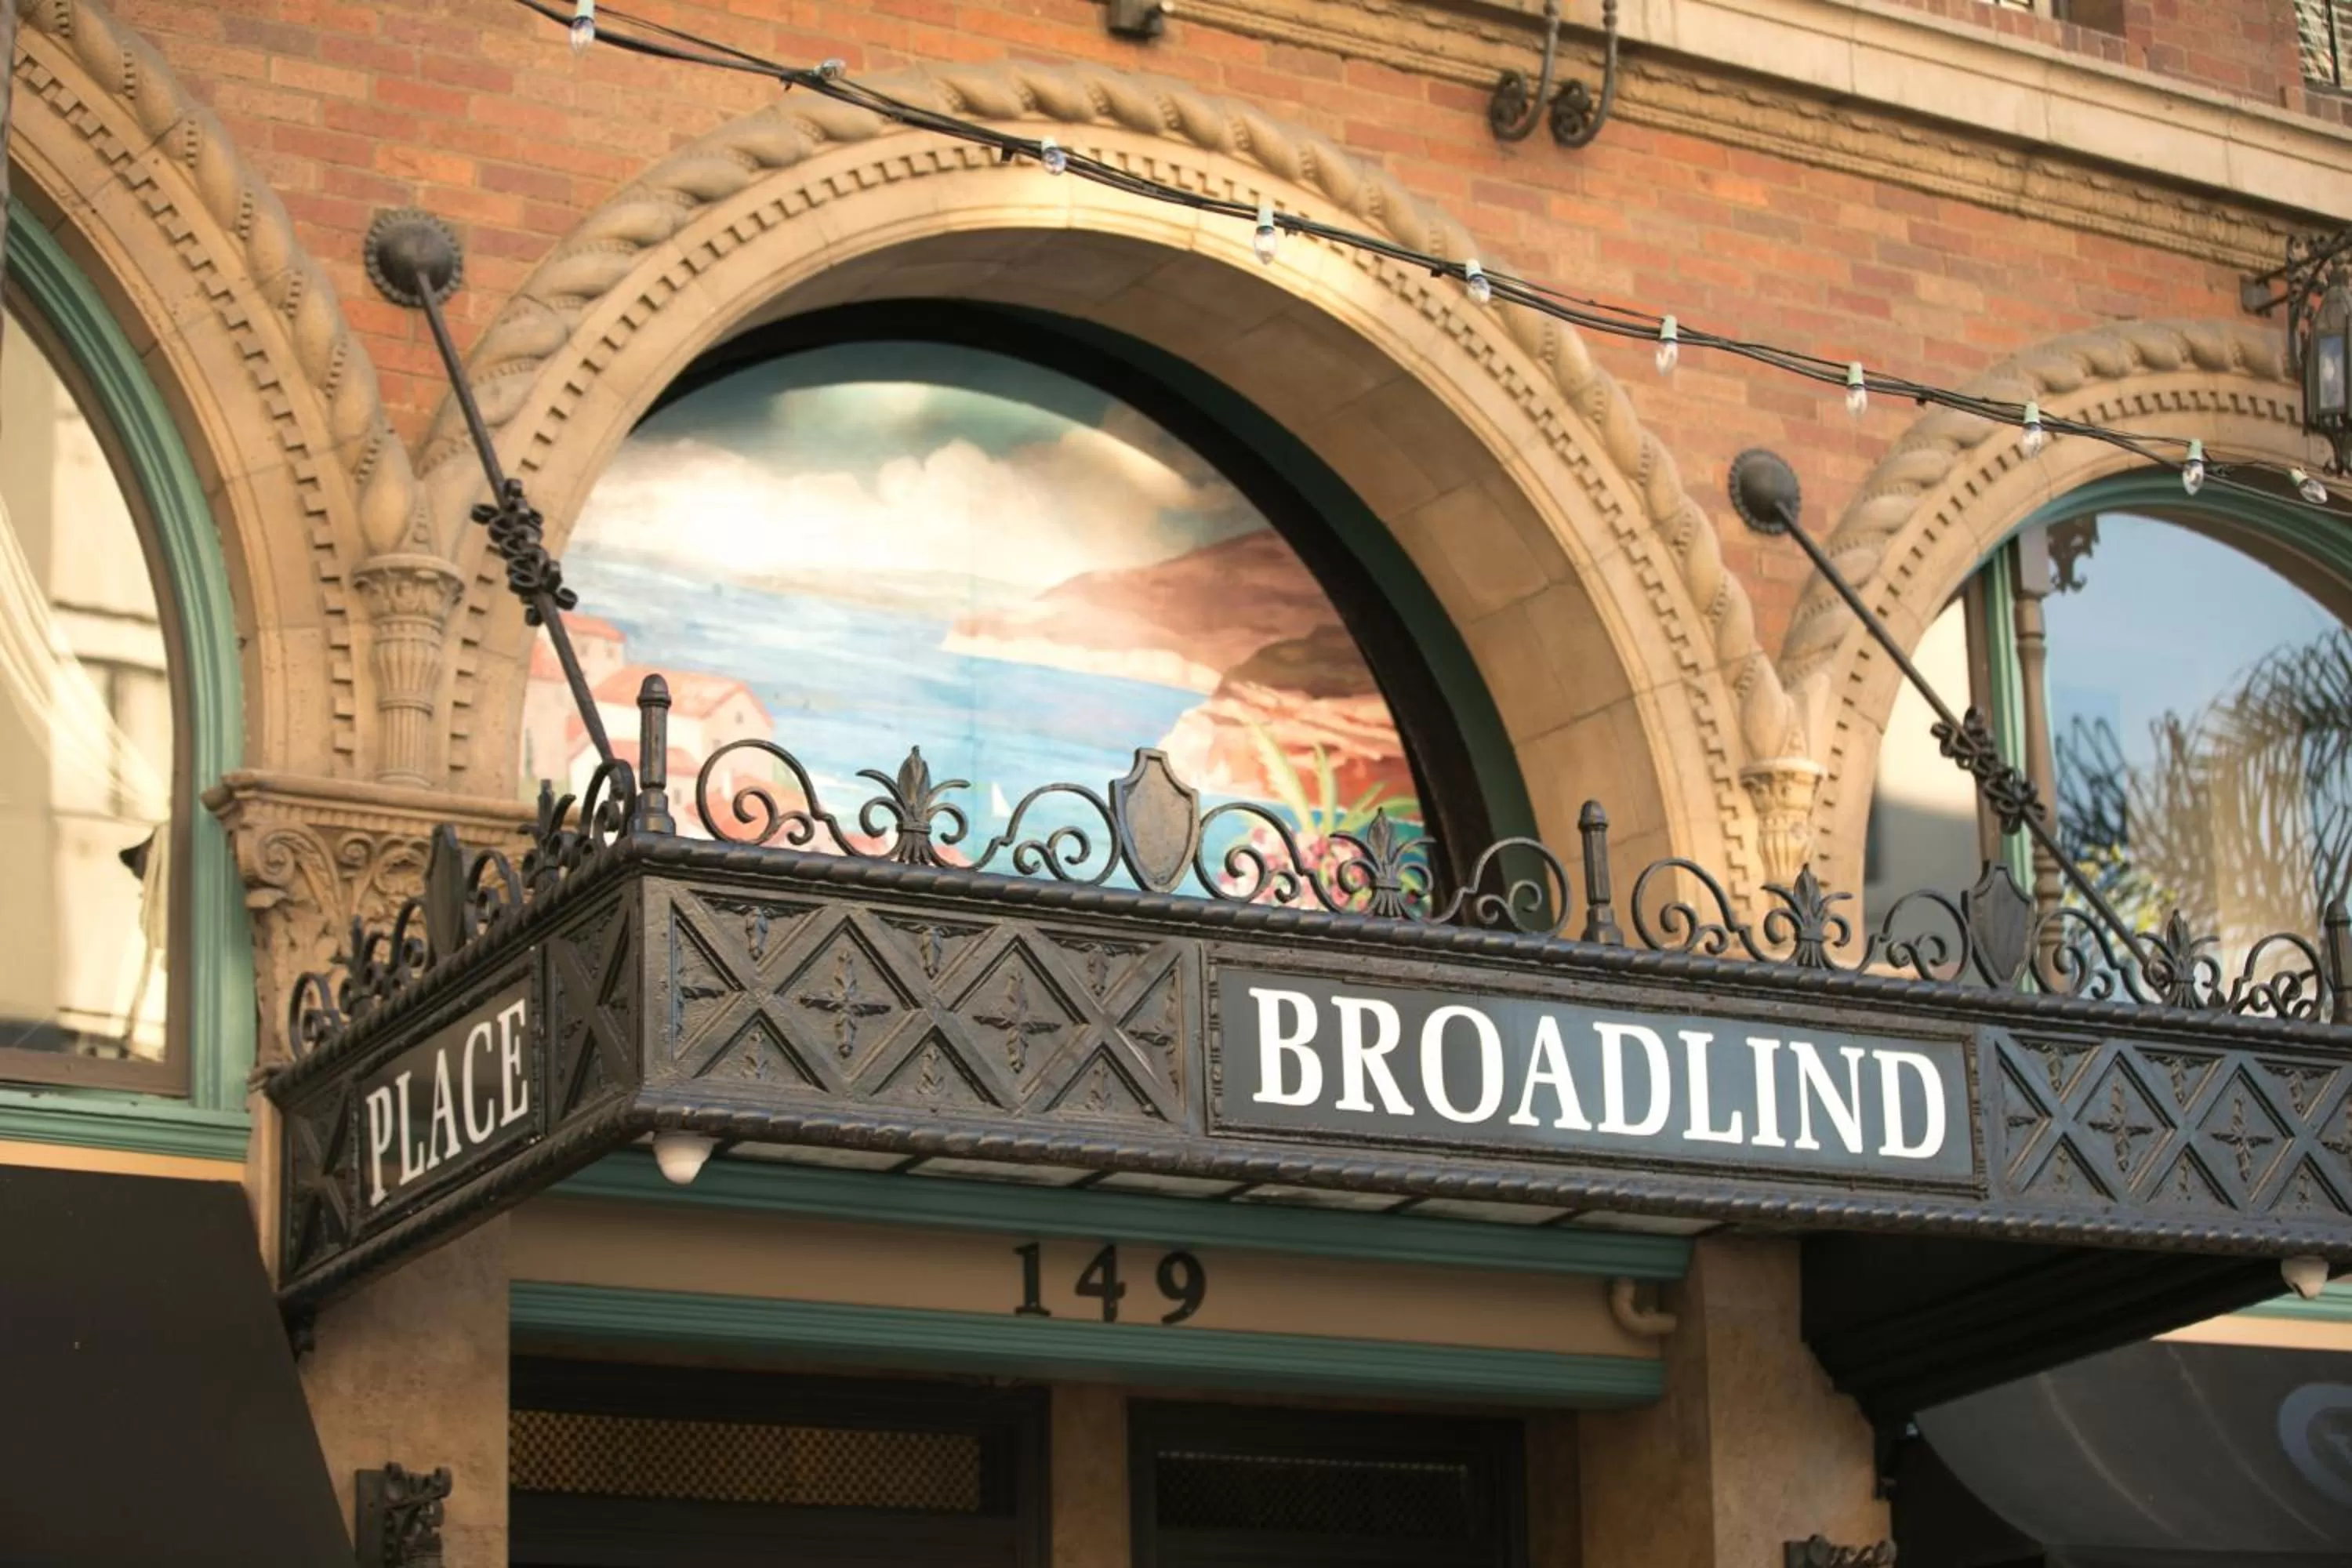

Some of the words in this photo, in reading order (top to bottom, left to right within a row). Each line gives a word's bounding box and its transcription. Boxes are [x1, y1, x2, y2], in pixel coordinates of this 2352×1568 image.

[365, 997, 528, 1208] PLACE
[1249, 987, 1947, 1159] BROADLIND
[1013, 1241, 1207, 1324] 149
